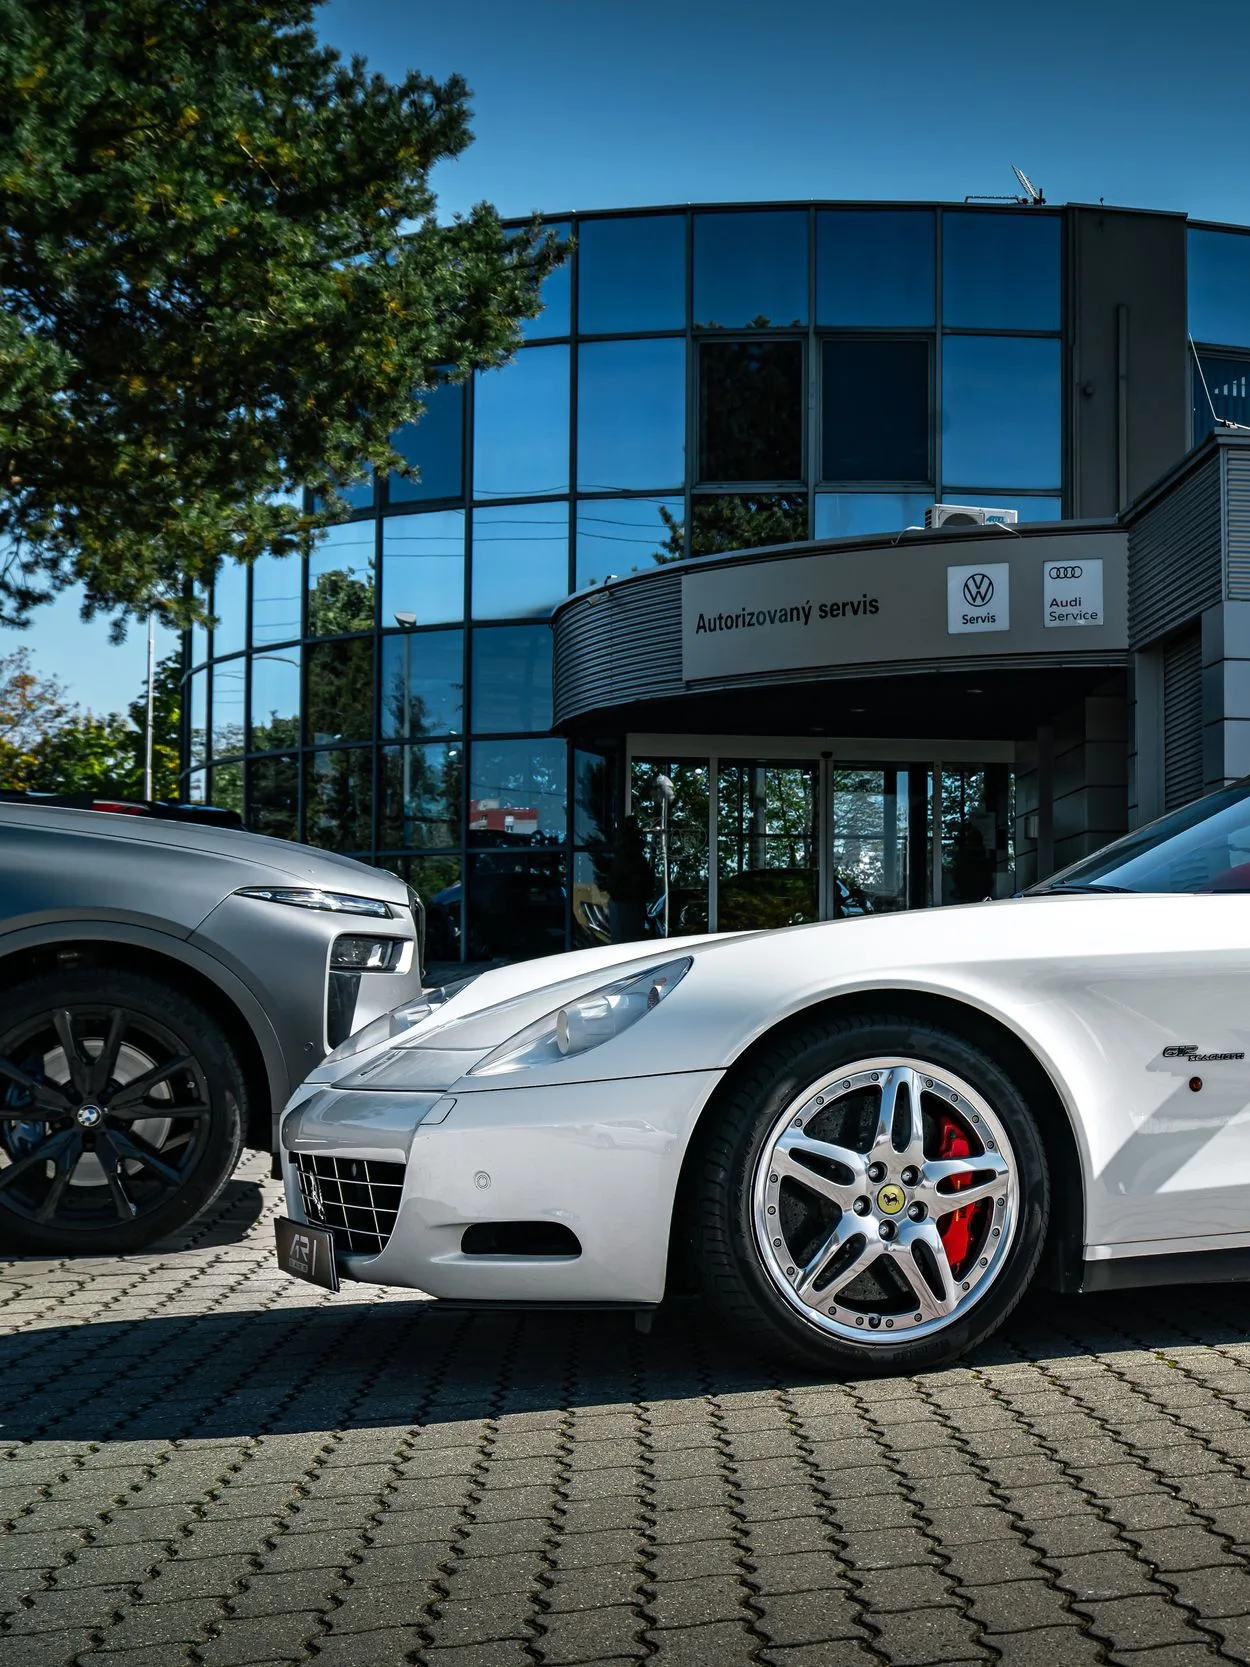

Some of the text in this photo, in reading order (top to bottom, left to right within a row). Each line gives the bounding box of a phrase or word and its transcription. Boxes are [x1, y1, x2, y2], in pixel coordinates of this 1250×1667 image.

[1049, 597, 1082, 608] Audi
[696, 594, 879, 634] Autorizovaný servis
[962, 612, 996, 625] Servis
[1049, 610, 1098, 622] Service
